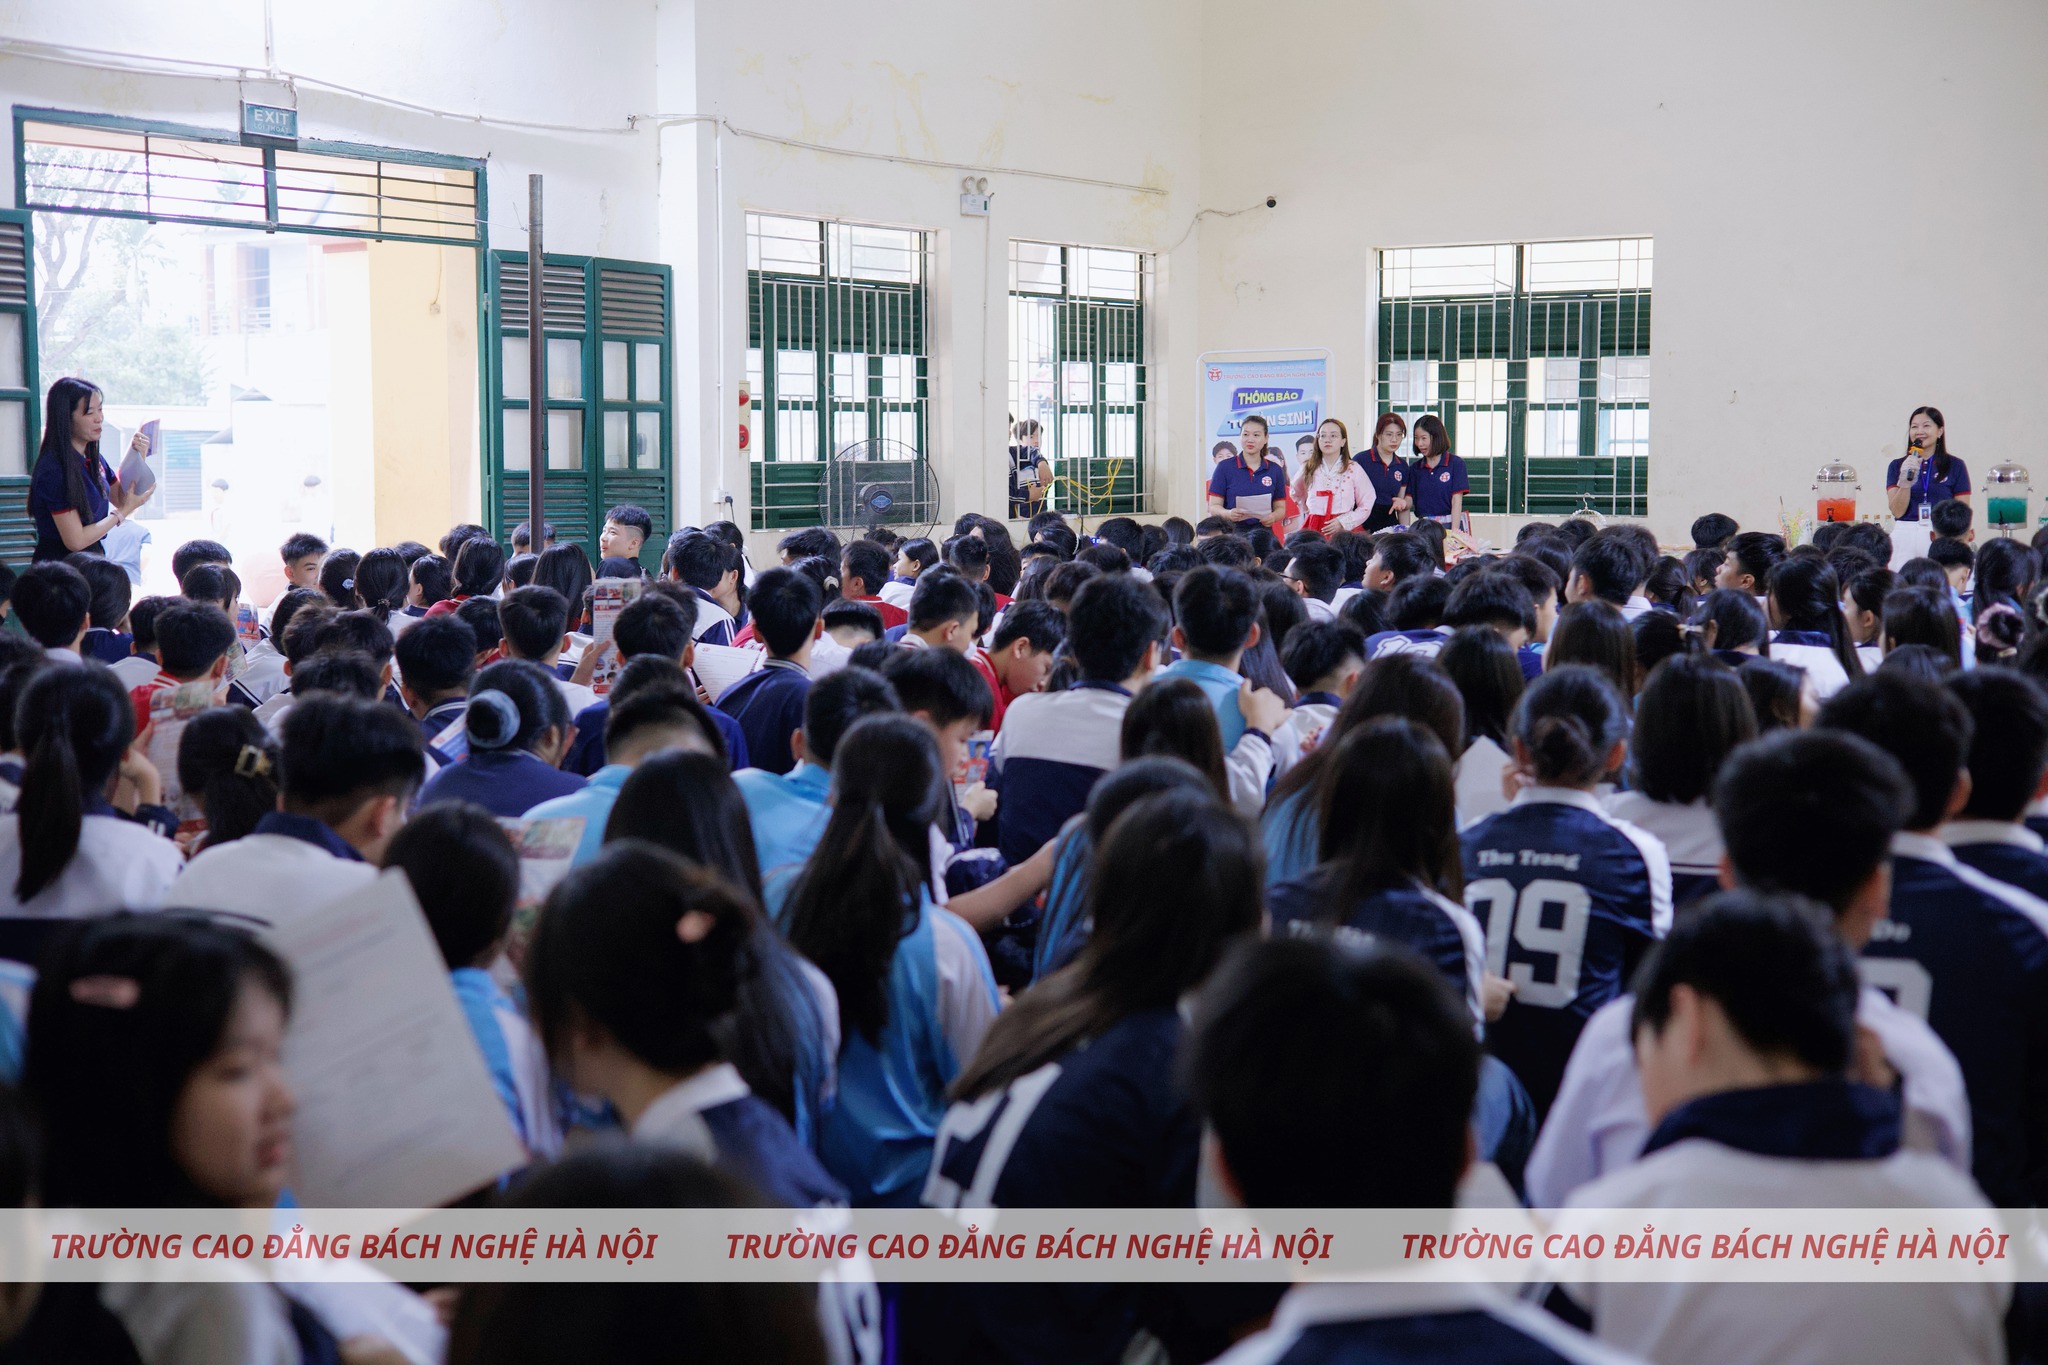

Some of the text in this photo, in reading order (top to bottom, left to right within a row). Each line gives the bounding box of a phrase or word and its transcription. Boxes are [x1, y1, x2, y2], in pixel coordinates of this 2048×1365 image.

[254, 109, 289, 125] EXIT
[1238, 390, 1299, 405] THÔNG BÁO
[1278, 410, 1314, 426] SINH
[1519, 849, 1580, 872] Trang
